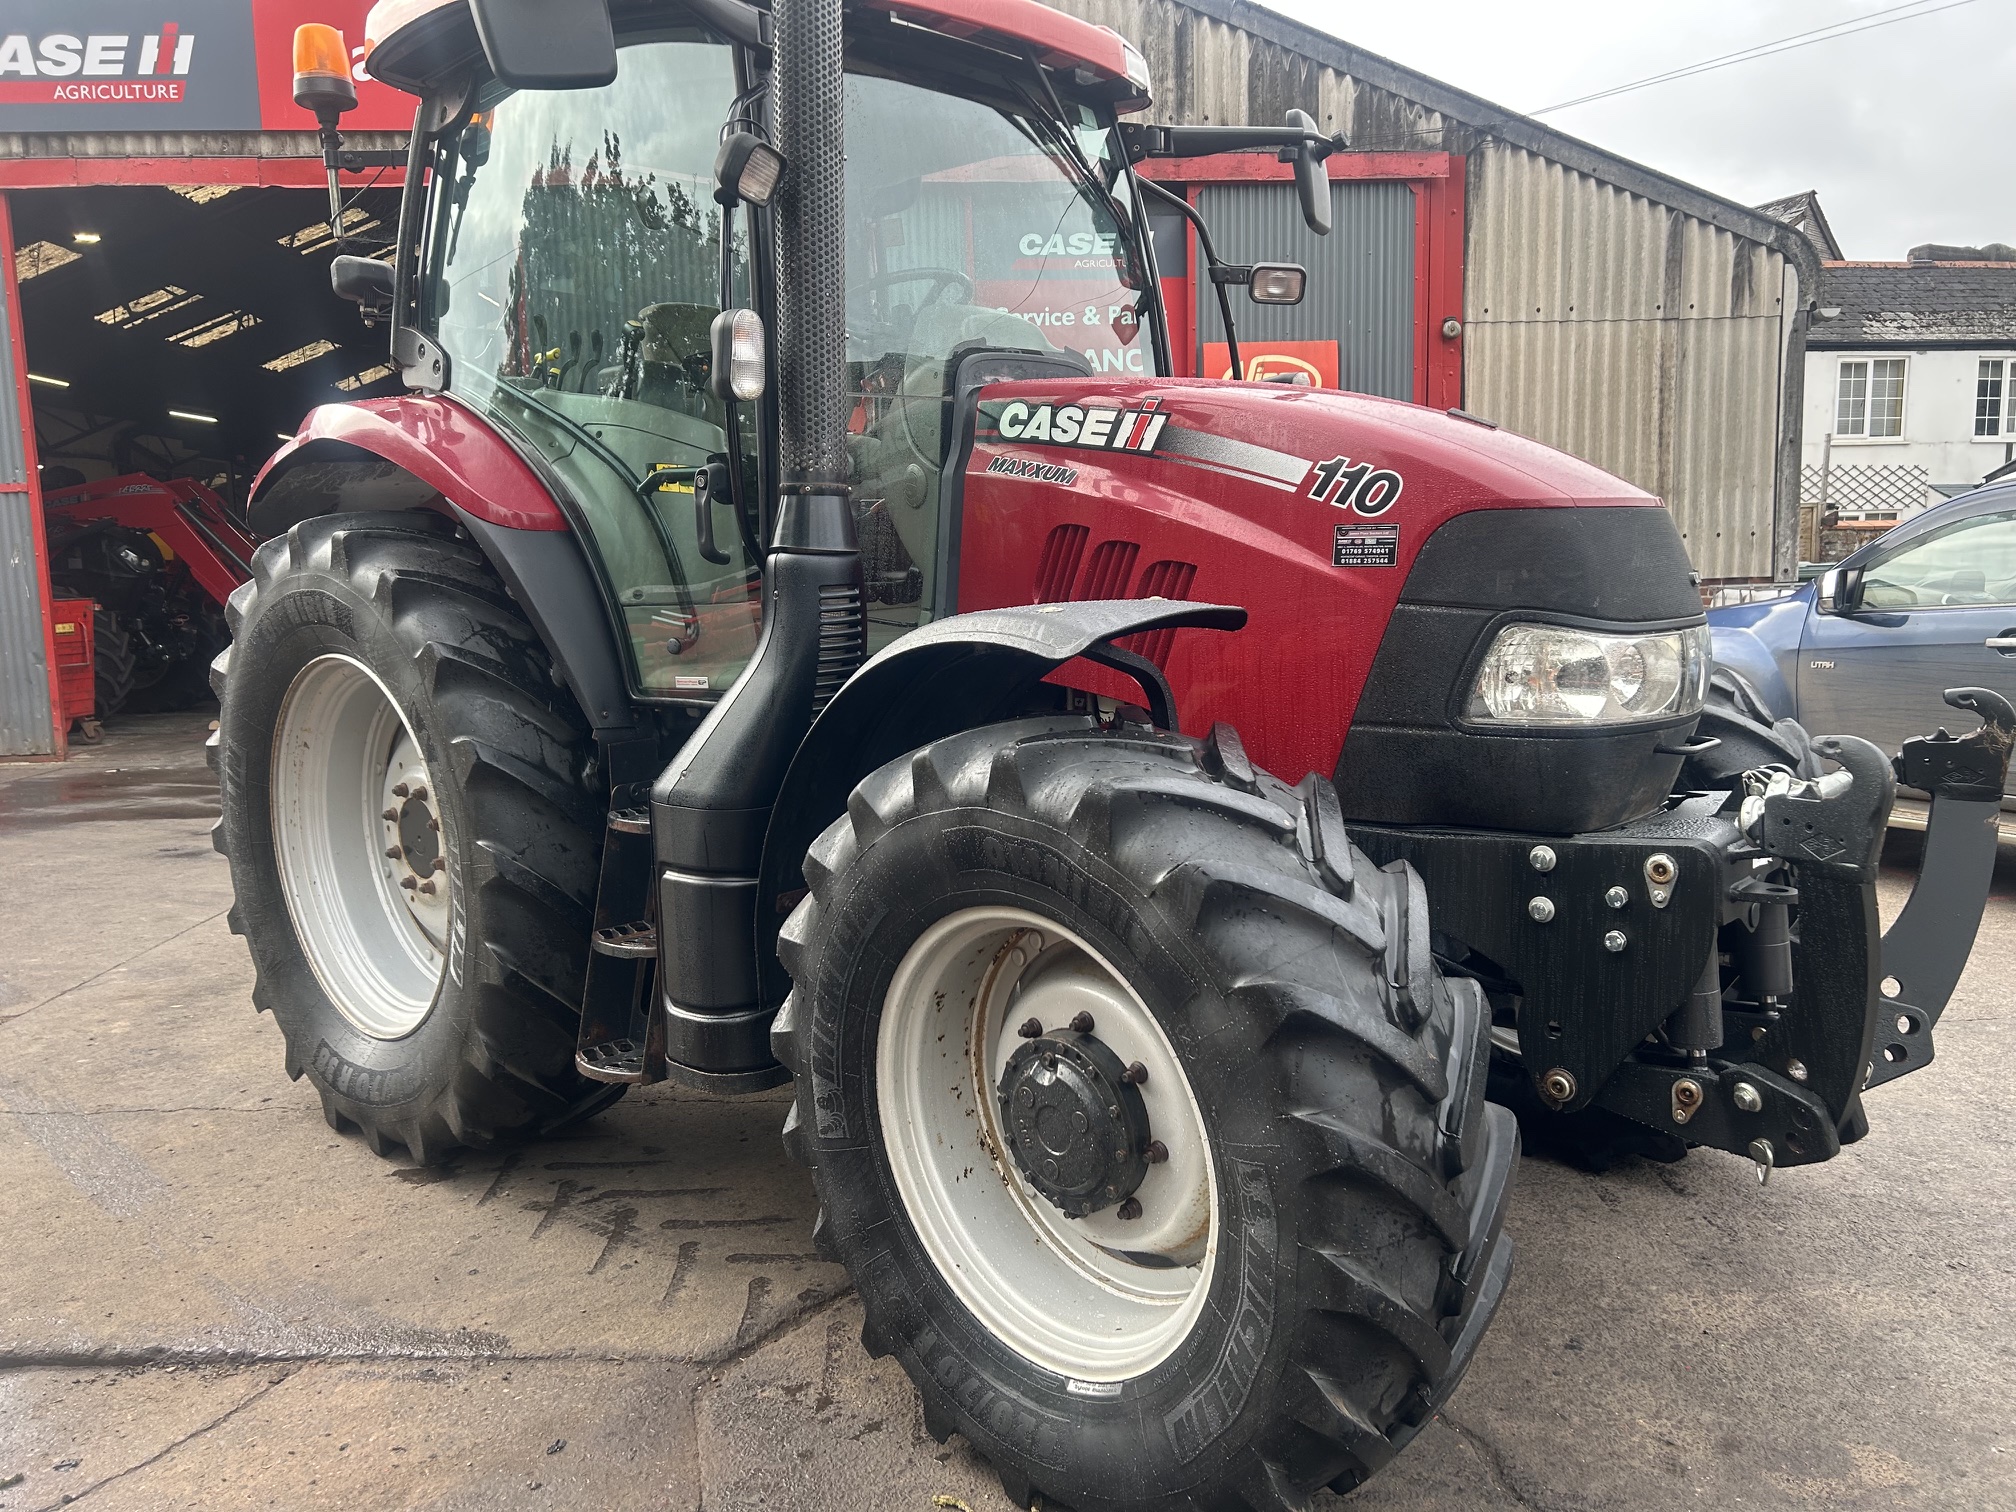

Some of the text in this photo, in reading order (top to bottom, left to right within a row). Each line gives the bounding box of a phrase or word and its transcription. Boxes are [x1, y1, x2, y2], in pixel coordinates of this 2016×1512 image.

[0, 22, 195, 76] ASE IH
[53, 84, 179, 100] AGRICULTURE
[1019, 232, 1117, 256] CASE
[1082, 305, 1101, 326] &
[1084, 348, 1143, 372] ANC
[998, 402, 1119, 447] CASE
[986, 456, 1078, 486] MAXXUM
[1307, 454, 1403, 517] 110
[1811, 661, 1834, 669] UTAH
[1167, 1228, 1276, 1464] MICHELIN
